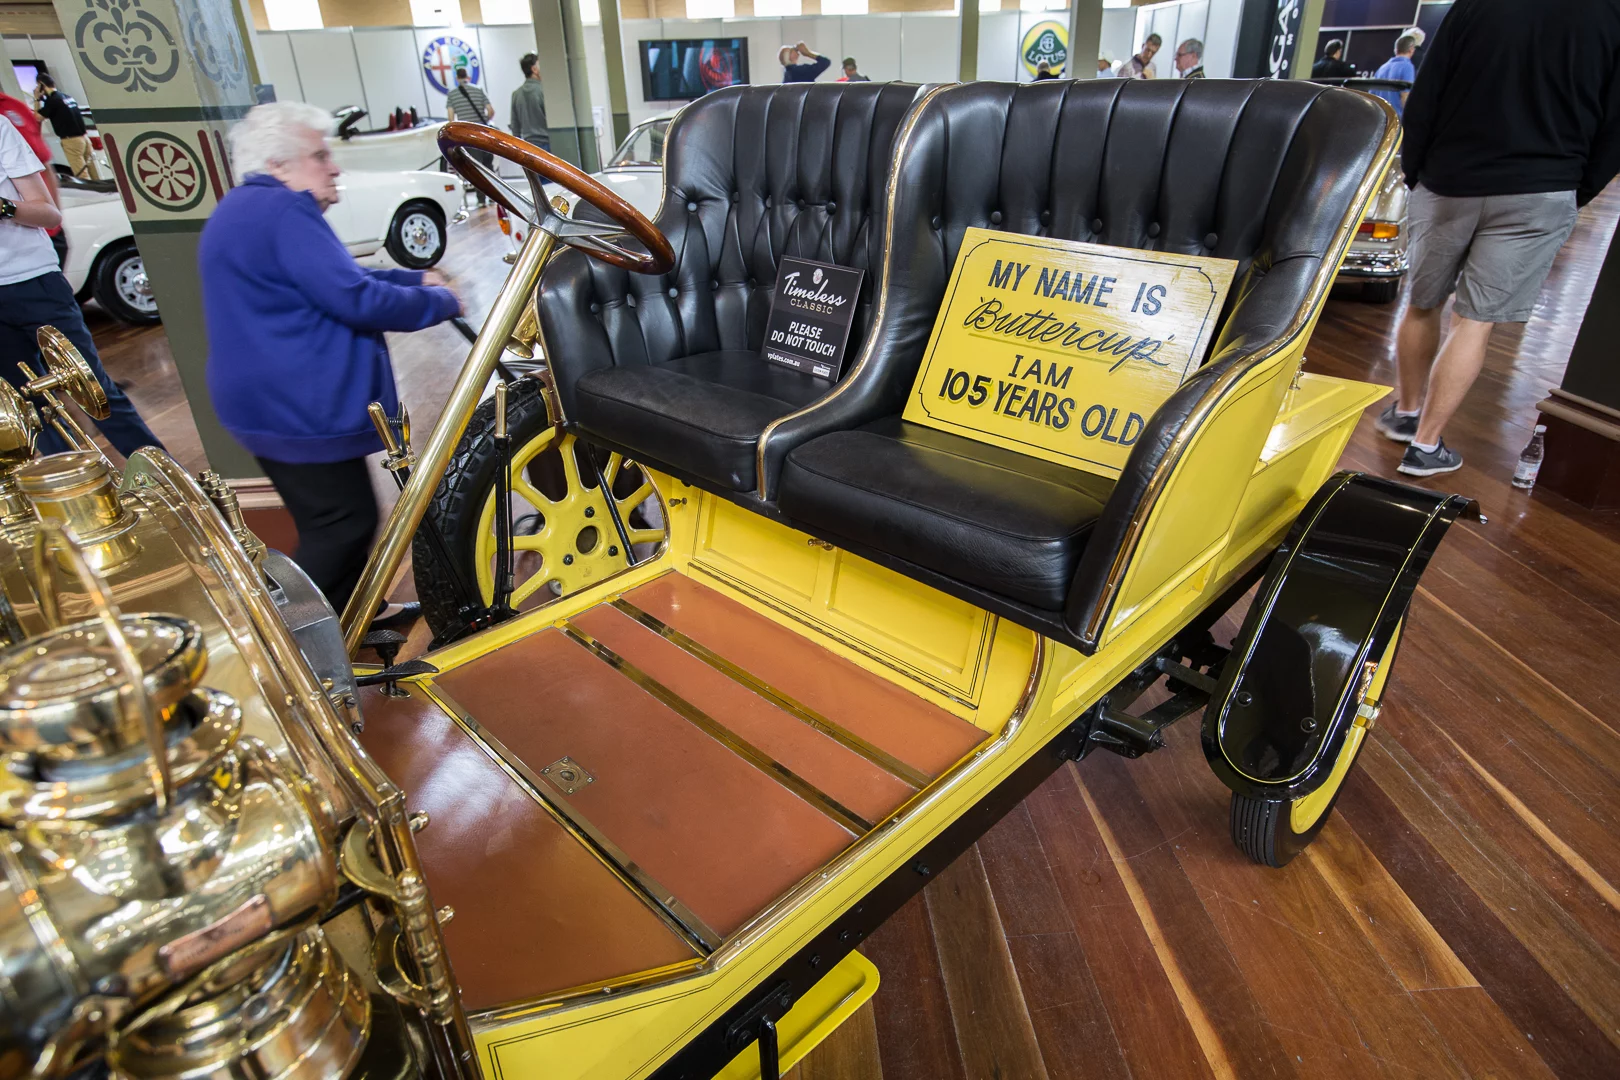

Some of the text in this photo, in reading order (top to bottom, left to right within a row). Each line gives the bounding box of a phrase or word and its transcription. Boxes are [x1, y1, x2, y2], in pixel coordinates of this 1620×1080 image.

[424, 36, 479, 69] ALFA ROMEO
[1028, 50, 1066, 63] LOTUS
[783, 272, 847, 306] Timeless
[988, 259, 1166, 316] MY NAME IS
[790, 298, 833, 315] CLASSIC
[771, 330, 836, 357] DO NOT TOUCH
[788, 321, 823, 340] PLEASE
[767, 352, 800, 367] vplates.com.au
[1008, 355, 1073, 389] I AM
[939, 368, 1146, 446] 105 YEARS OLD
